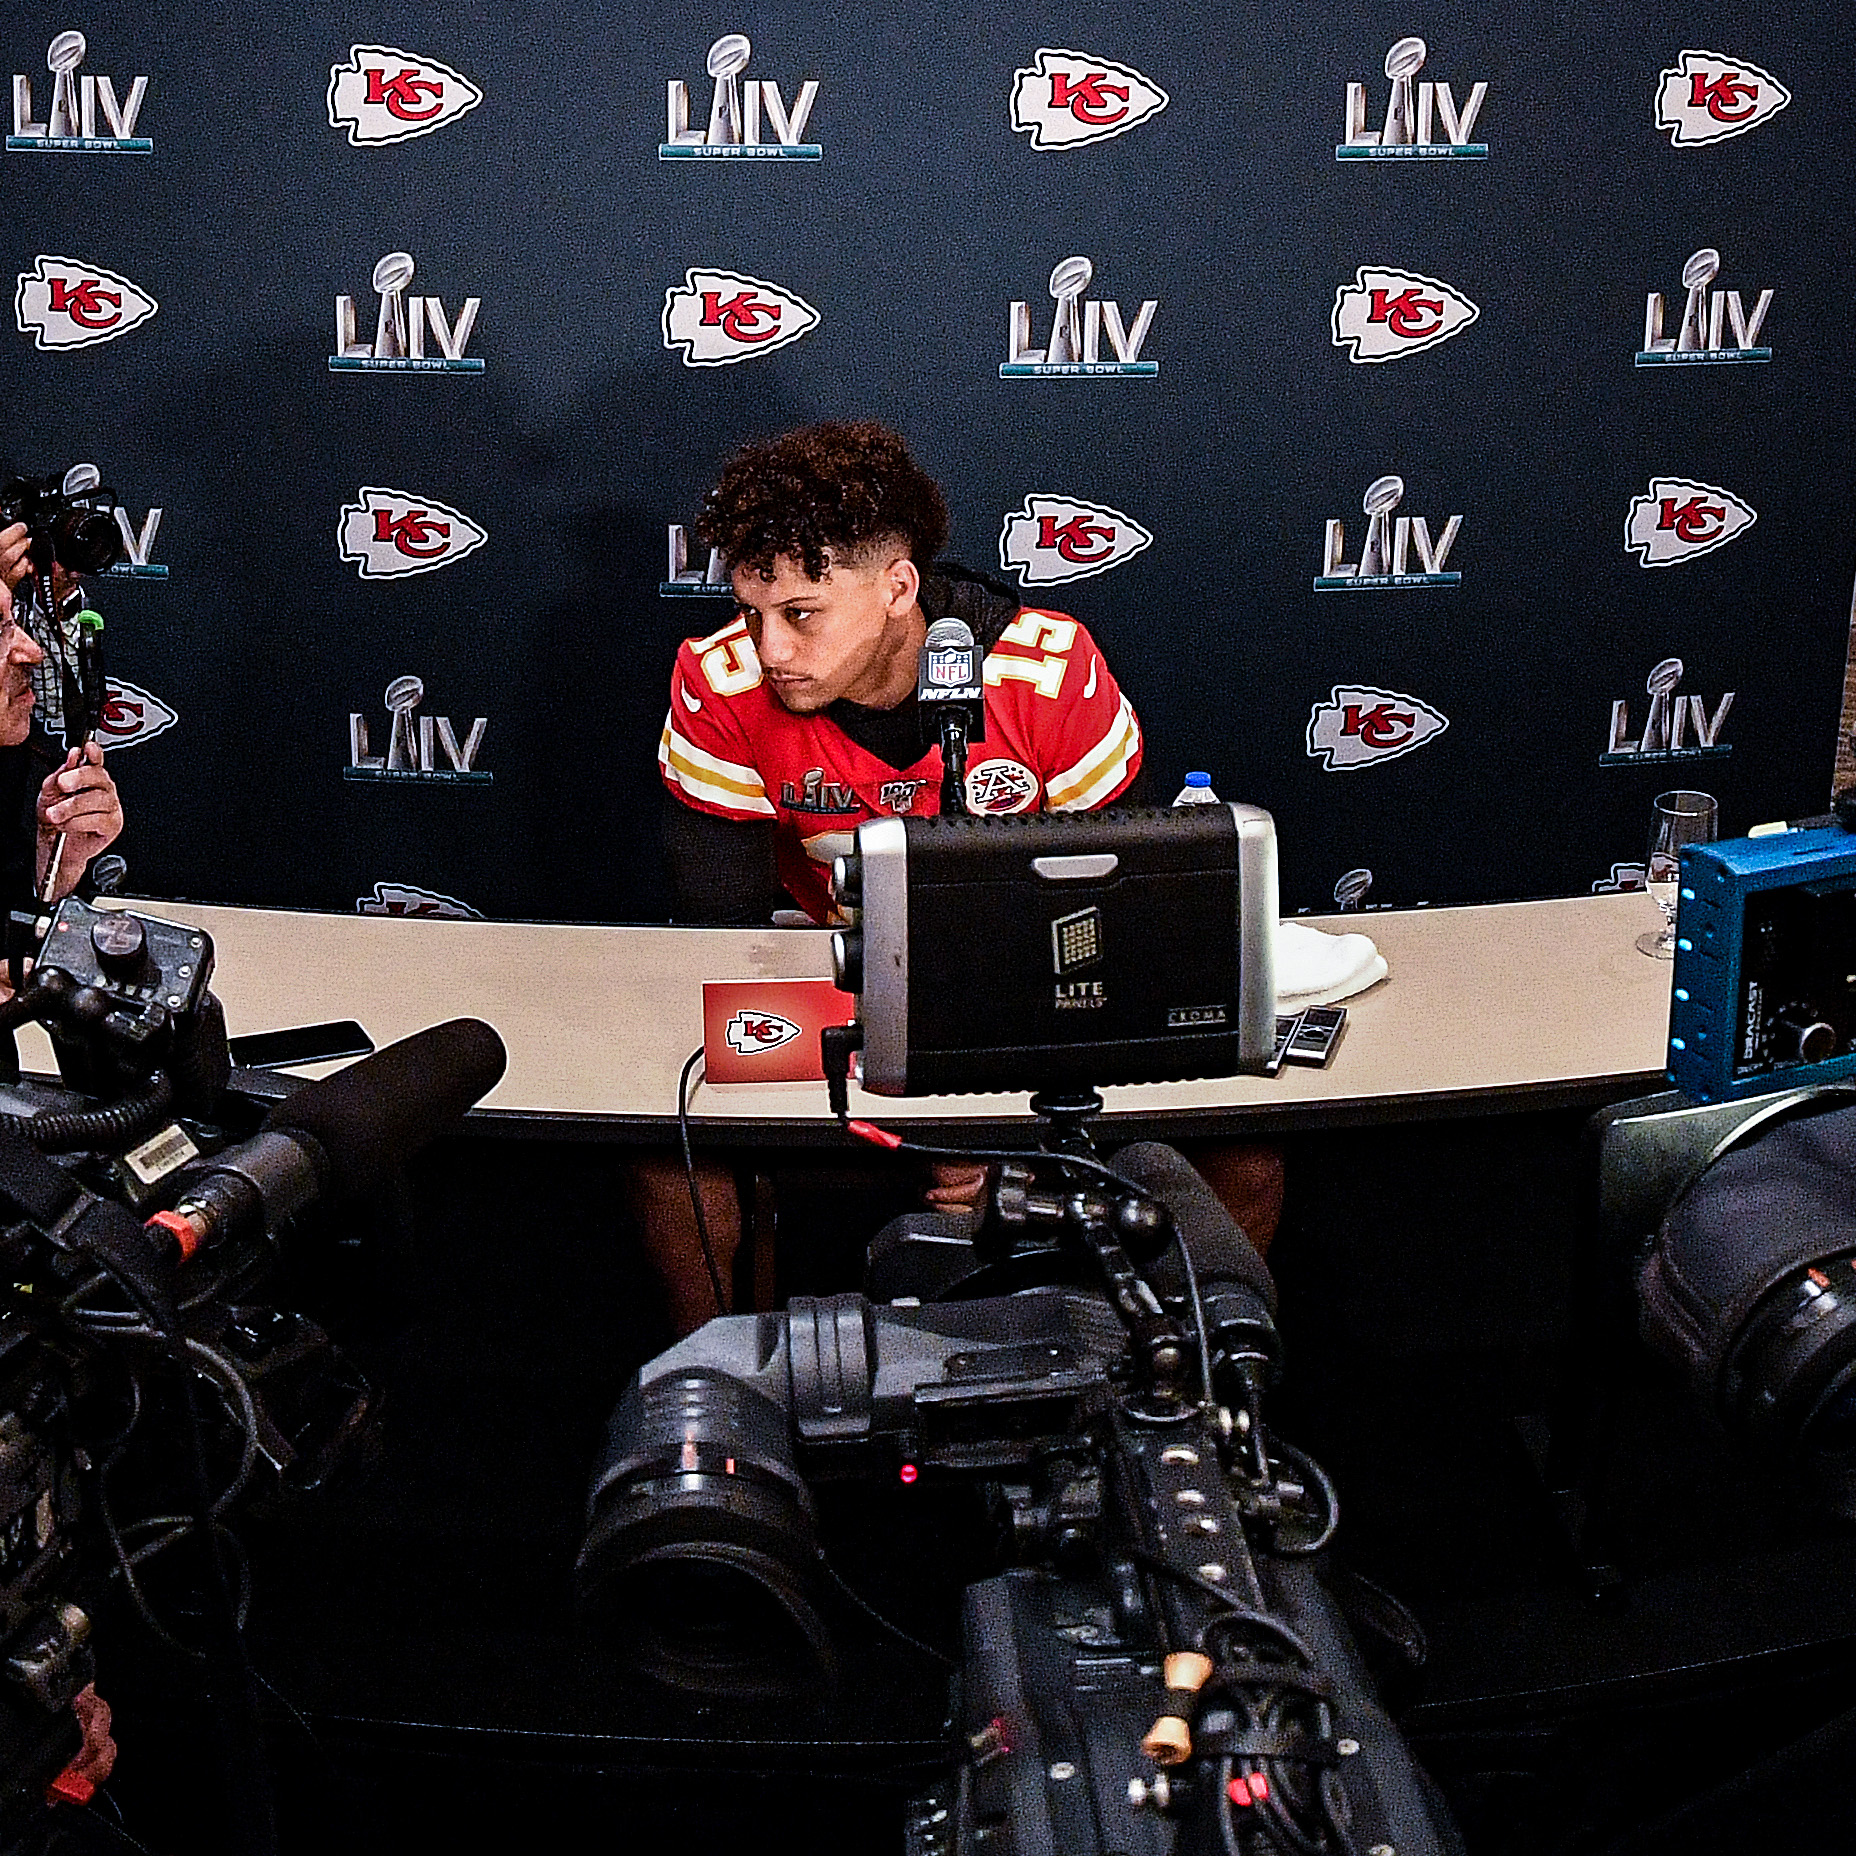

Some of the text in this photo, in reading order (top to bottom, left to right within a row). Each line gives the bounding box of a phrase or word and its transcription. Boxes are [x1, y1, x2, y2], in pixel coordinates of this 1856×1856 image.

[12, 75, 148, 138] LIV
[364, 68, 444, 120] KC
[667, 80, 820, 145] LIV
[1048, 73, 1130, 125] KC
[1345, 82, 1488, 145] LIV
[1688, 73, 1759, 123] KC
[48, 278, 122, 329] KC
[335, 295, 481, 360] LIV
[699, 292, 781, 343] KC
[1367, 288, 1444, 339] KC
[1646, 290, 1774, 352] LIV
[1010, 301, 1158, 363] LIV
[373, 510, 452, 558] KC
[1036, 516, 1116, 563] KC
[1323, 515, 1463, 577] LIV
[1656, 498, 1726, 543] KC
[935, 664, 968, 682] NFL
[983, 610, 1078, 699] 15
[349, 713, 487, 771] LIV
[1340, 704, 1415, 749] KC
[1608, 692, 1736, 753] LIV
[1055, 982, 1103, 998] LITE
[744, 1020, 783, 1043] KC
